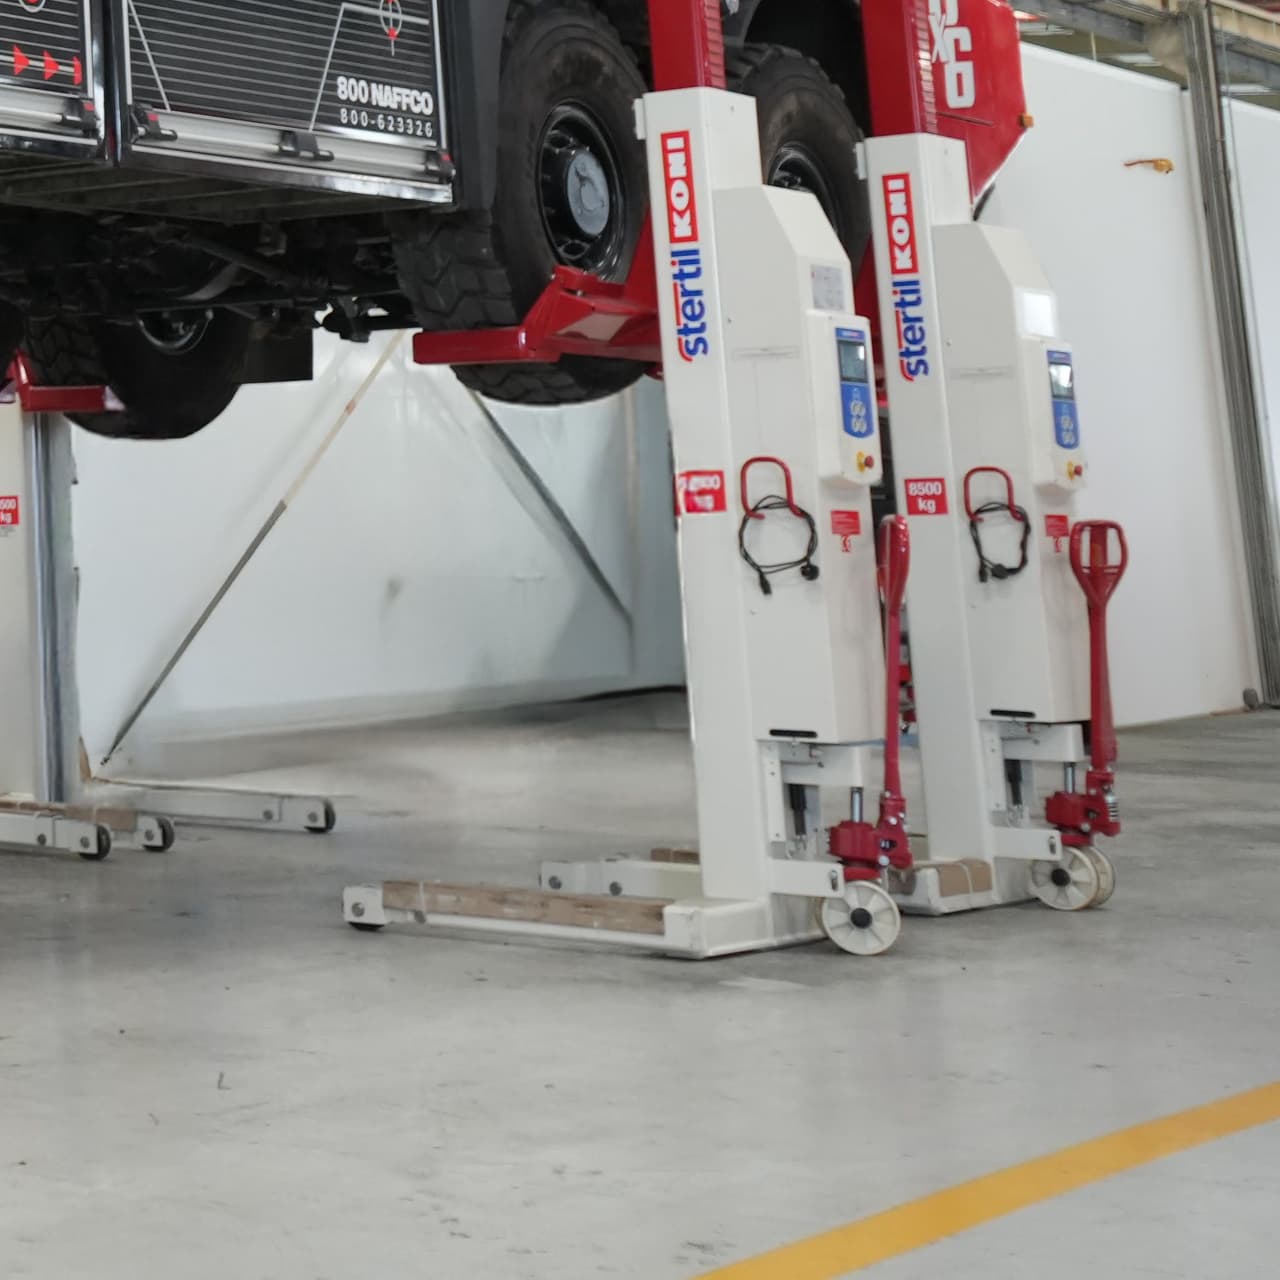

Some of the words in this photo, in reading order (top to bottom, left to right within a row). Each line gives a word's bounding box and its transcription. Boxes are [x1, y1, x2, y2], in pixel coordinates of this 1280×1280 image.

[336, 76, 369, 104] 800
[370, 82, 434, 116] NAFFCO
[340, 108, 433, 138] 800-623326
[666, 137, 692, 238] KONI
[887, 179, 913, 270] KONI
[671, 249, 709, 363] stertil
[894, 280, 929, 382] stertil
